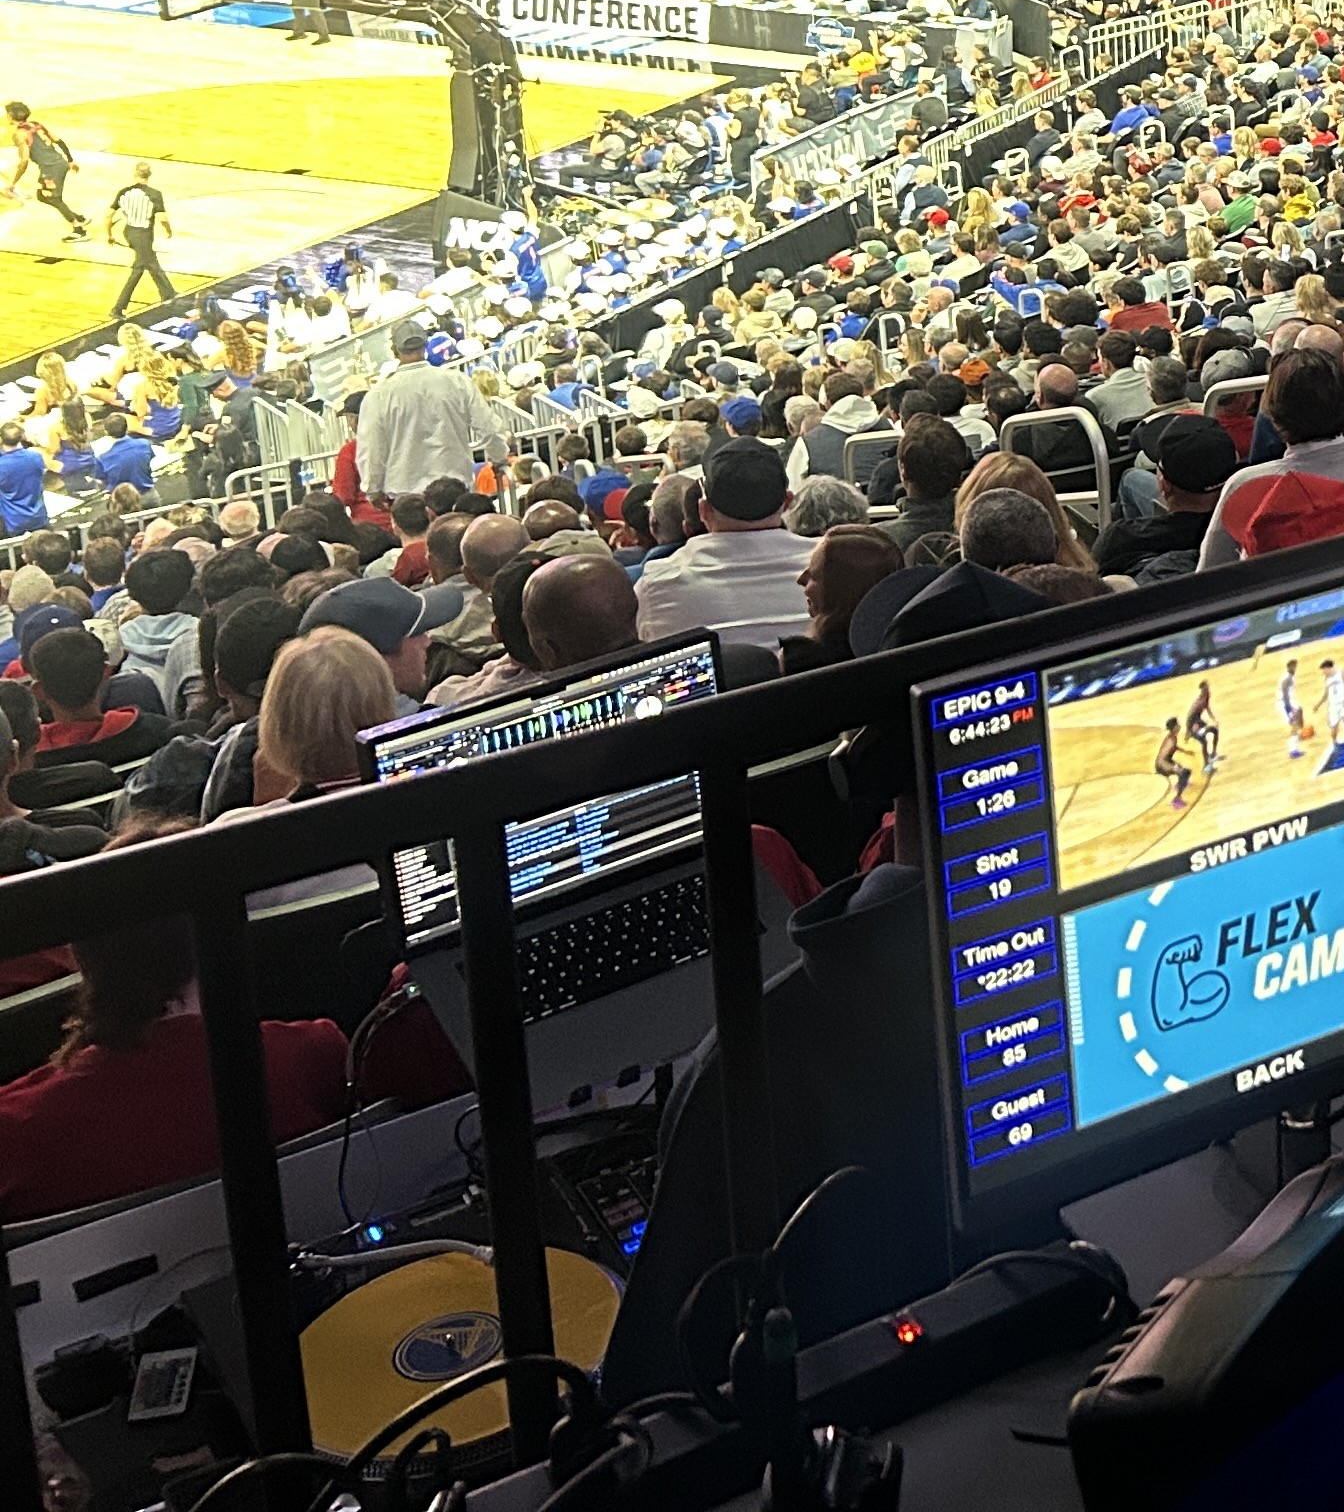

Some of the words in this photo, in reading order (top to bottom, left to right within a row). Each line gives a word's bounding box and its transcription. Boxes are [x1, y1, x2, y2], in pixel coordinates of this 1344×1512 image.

[943, 691, 991, 720] EPIC
[949, 713, 1011, 745] 6:44:23
[962, 761, 1019, 789] Game
[976, 789, 1016, 816] 1:26
[1190, 838, 1247, 872] SWR
[1252, 816, 1308, 852] PVW
[976, 848, 1019, 875] Shot
[989, 878, 1012, 900] 19
[1216, 889, 1322, 967] FLEX
[962, 940, 1009, 967] Time
[1011, 927, 1045, 951] Out
[986, 1017, 1039, 1047] Home
[1235, 1049, 1305, 1094] BACK
[991, 1089, 1045, 1121] Guest
